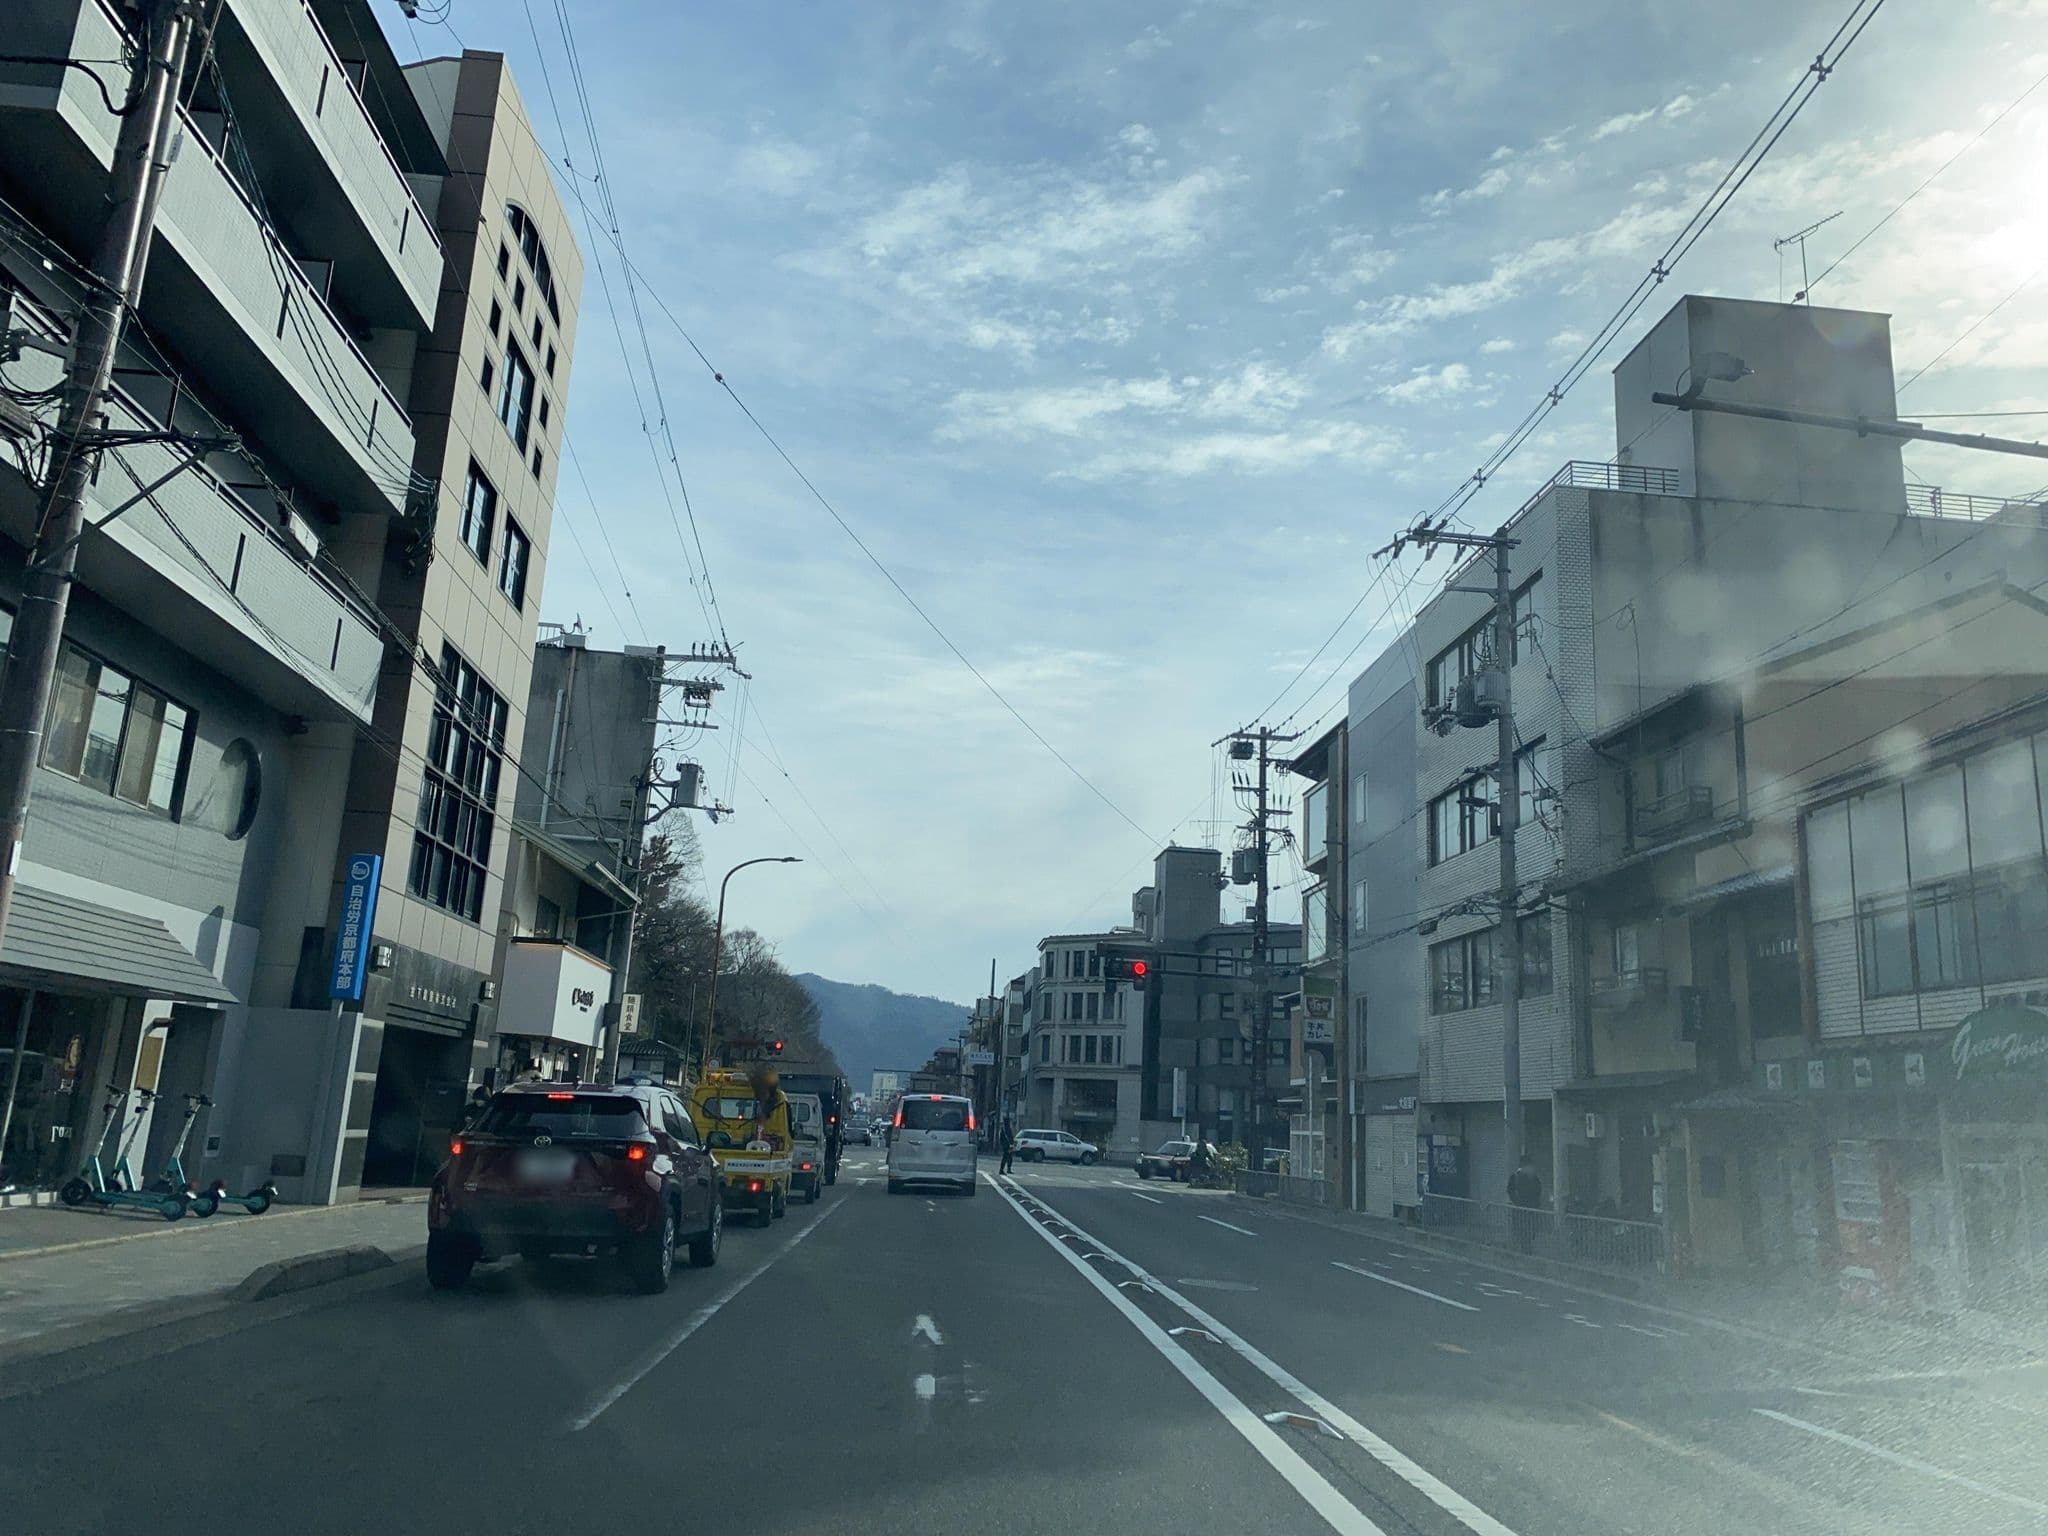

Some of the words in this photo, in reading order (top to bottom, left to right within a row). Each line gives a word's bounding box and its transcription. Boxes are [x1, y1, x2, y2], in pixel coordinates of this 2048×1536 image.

[336, 884, 364, 990] 自治労京都府本部
[1307, 1031, 1332, 1040] カレー
